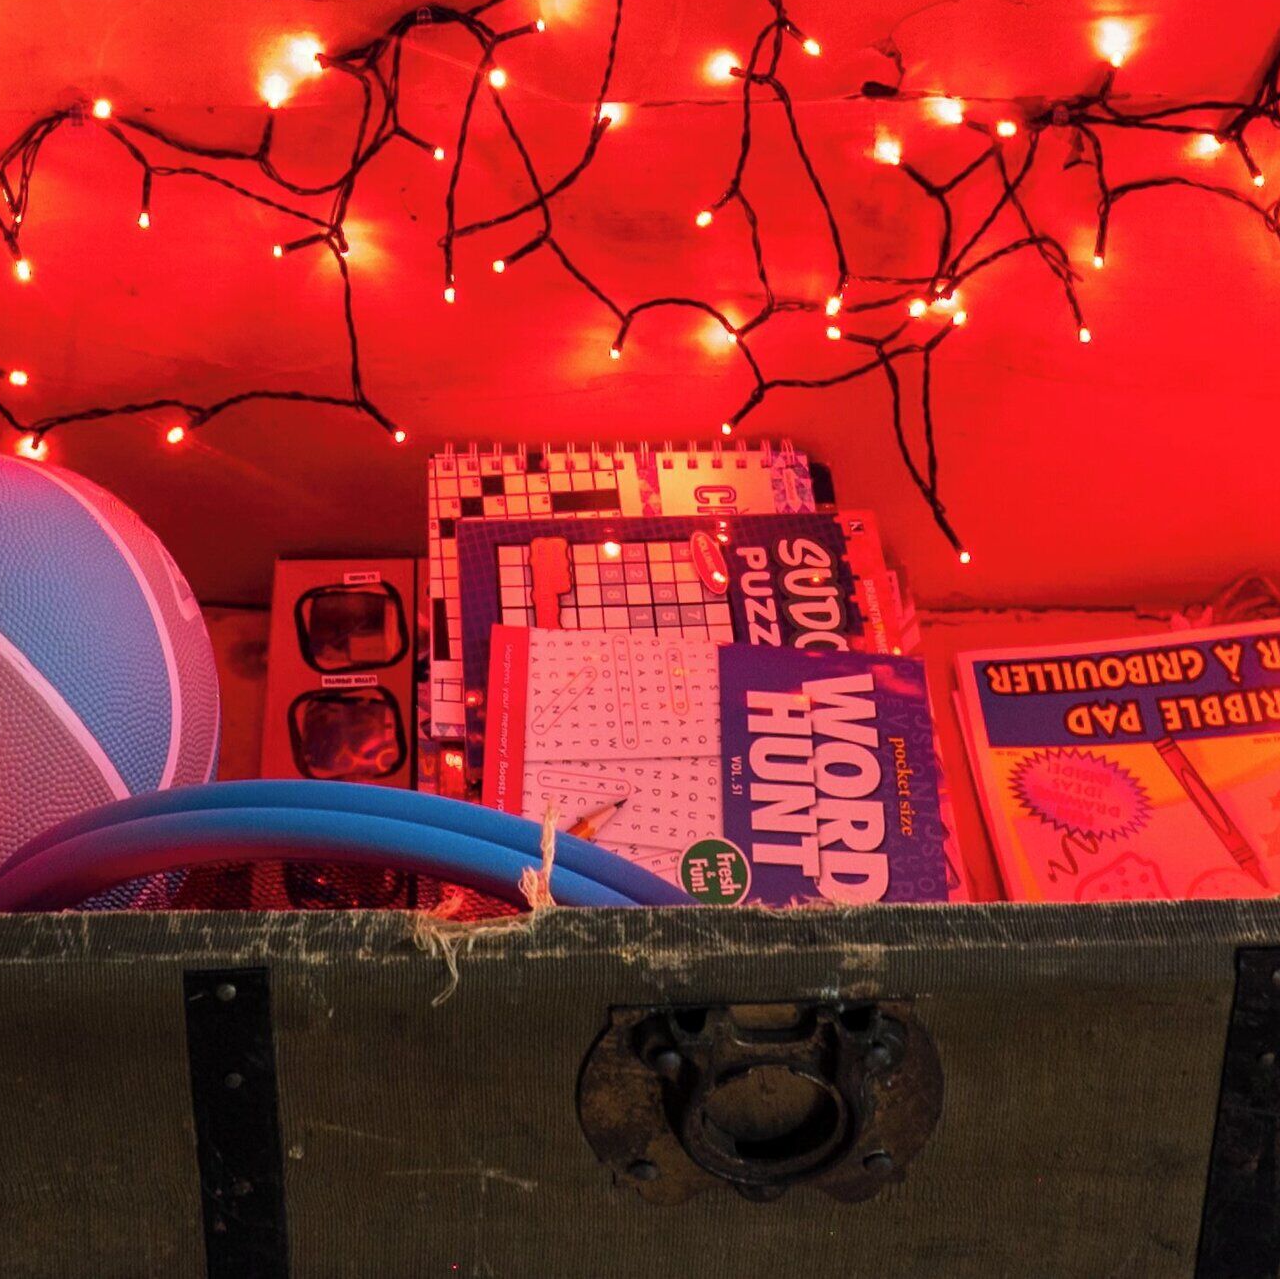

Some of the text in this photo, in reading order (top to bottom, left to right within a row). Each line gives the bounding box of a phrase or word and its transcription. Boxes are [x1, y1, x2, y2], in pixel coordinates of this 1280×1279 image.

[503, 643, 514, 685] Sharpens
[986, 649, 1205, 693] GRIBOUILLER
[1213, 642, 1243, 683] À
[501, 687, 510, 710] your
[1066, 701, 1142, 735] PAD
[498, 761, 509, 795] Boosts
[746, 690, 820, 877] HUNT
[801, 673, 889, 904] WORD
[888, 737, 917, 836] pocket size
[1051, 779, 1103, 800] IDEAS
[688, 858, 709, 892] Fun!
[706, 871, 717, 879] &
[716, 852, 742, 896] Fresh
